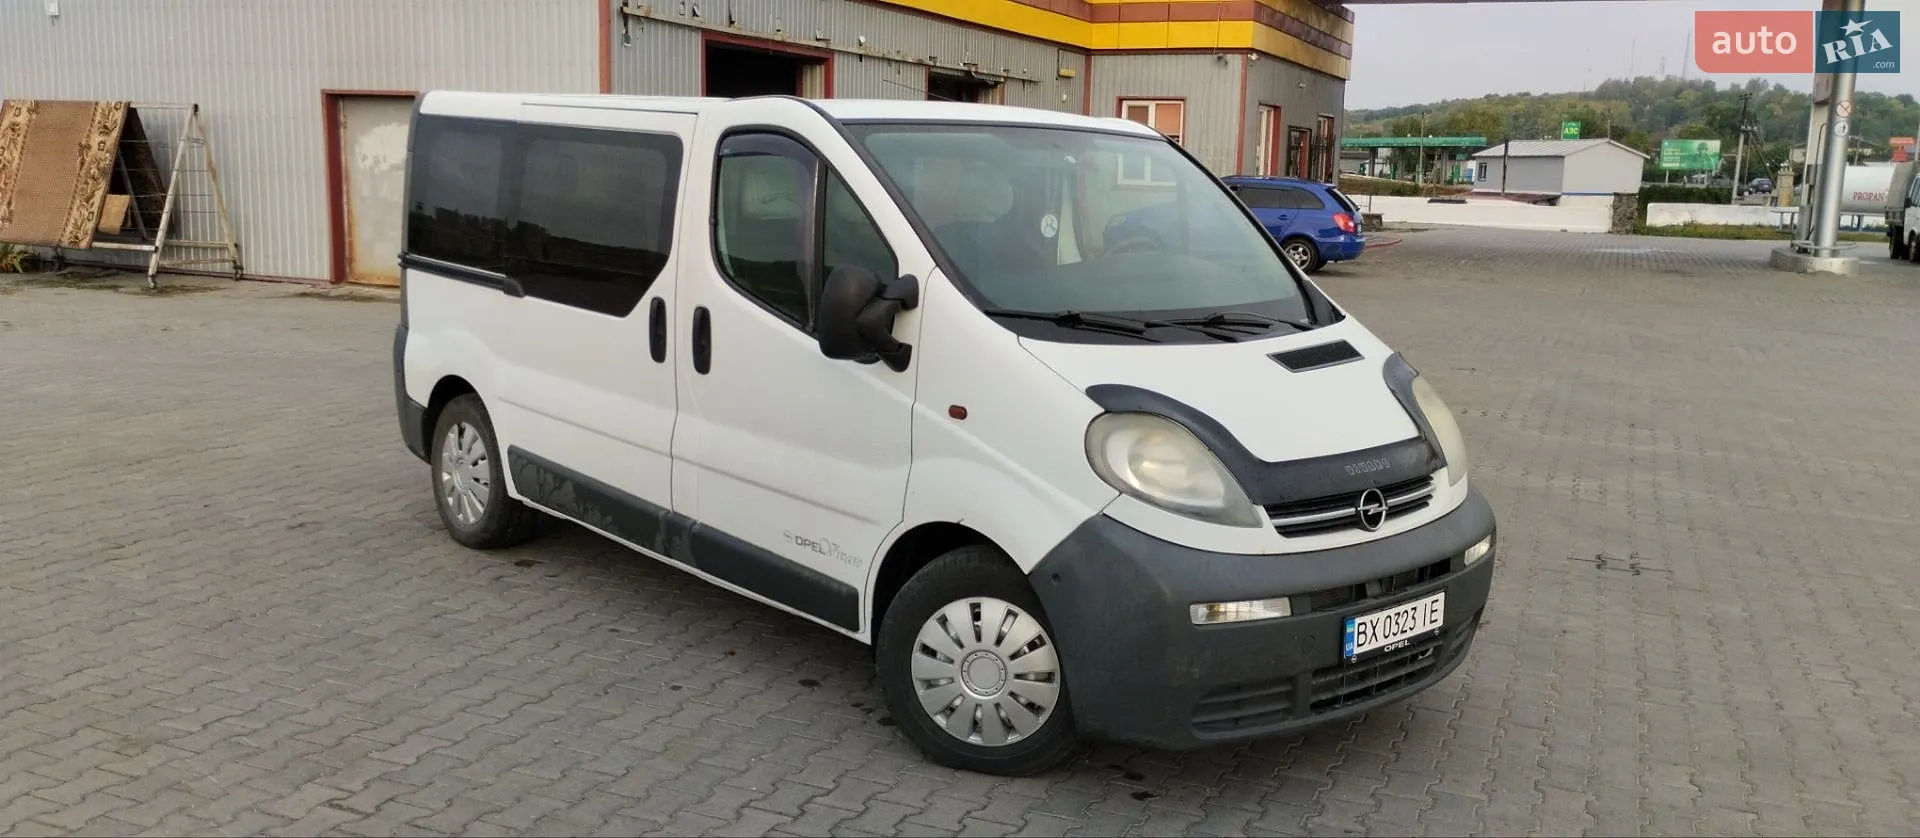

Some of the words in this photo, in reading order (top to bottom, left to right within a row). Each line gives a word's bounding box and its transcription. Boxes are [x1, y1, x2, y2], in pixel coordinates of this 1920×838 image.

[795, 535, 826, 555] OPEL
[1356, 618, 1380, 648] BX
[1383, 606, 1417, 639] 0323
[1423, 599, 1439, 627] IE
[1384, 639, 1410, 652] OPEL
